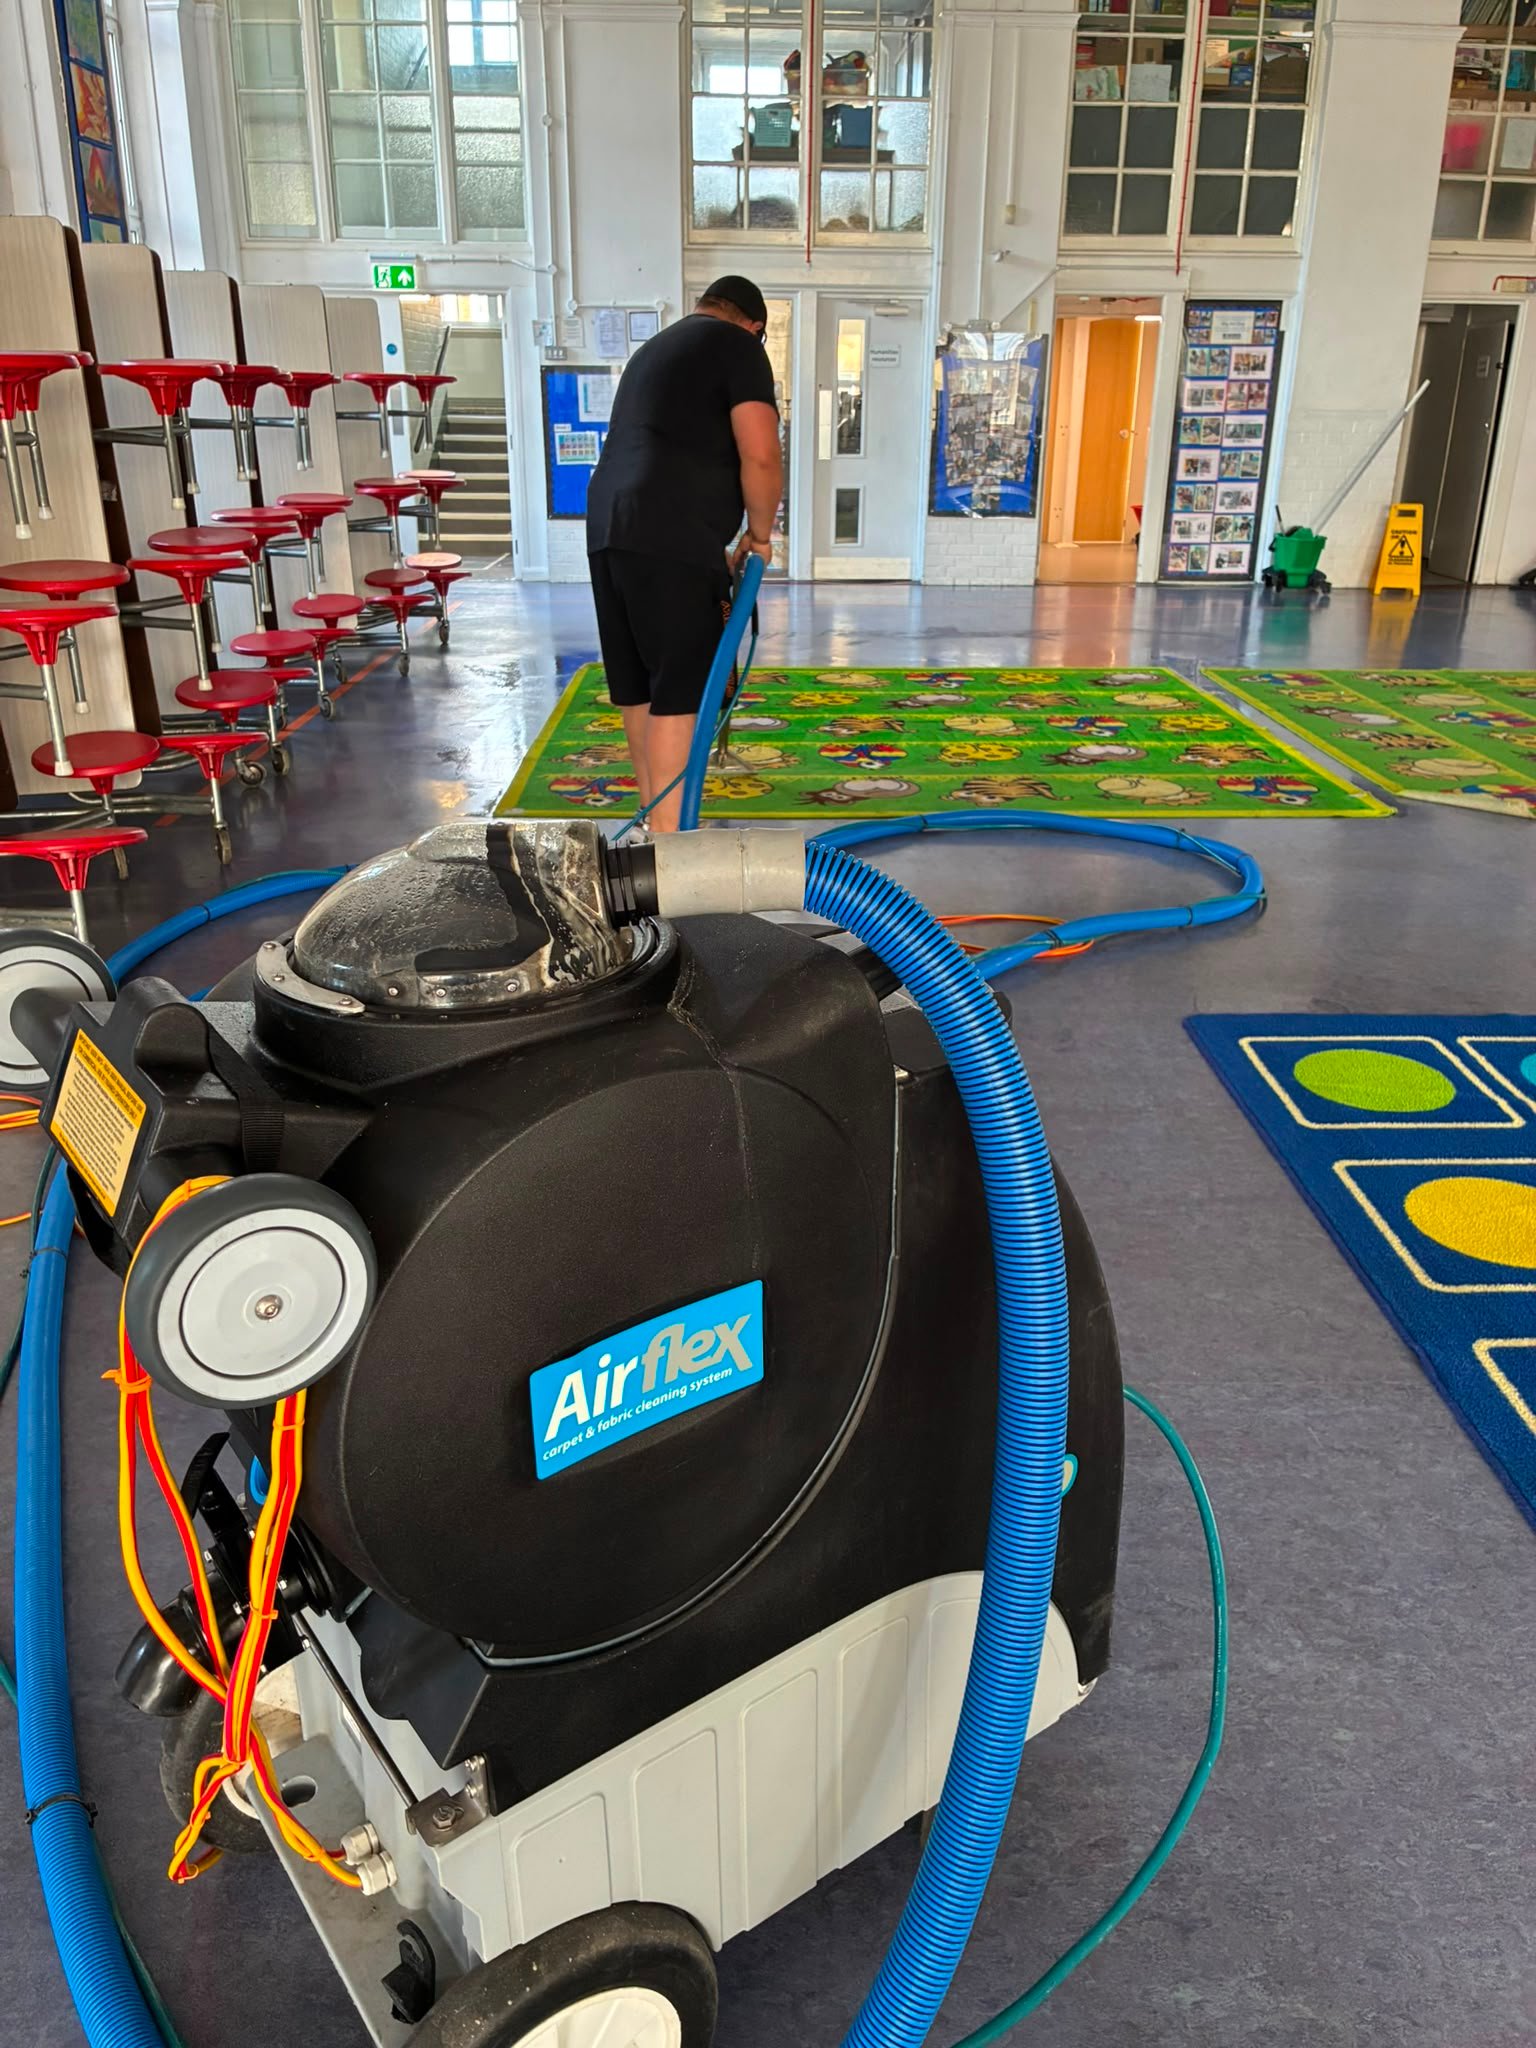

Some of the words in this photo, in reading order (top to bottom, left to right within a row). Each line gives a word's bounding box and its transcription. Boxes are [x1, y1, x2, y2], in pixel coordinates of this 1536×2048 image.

[543, 1432, 584, 1461] carpet
[585, 1426, 595, 1439] &
[597, 1410, 633, 1433] fabric
[635, 1386, 687, 1414] cleaning
[689, 1367, 732, 1391] system
[544, 1314, 753, 1442] Airflex
